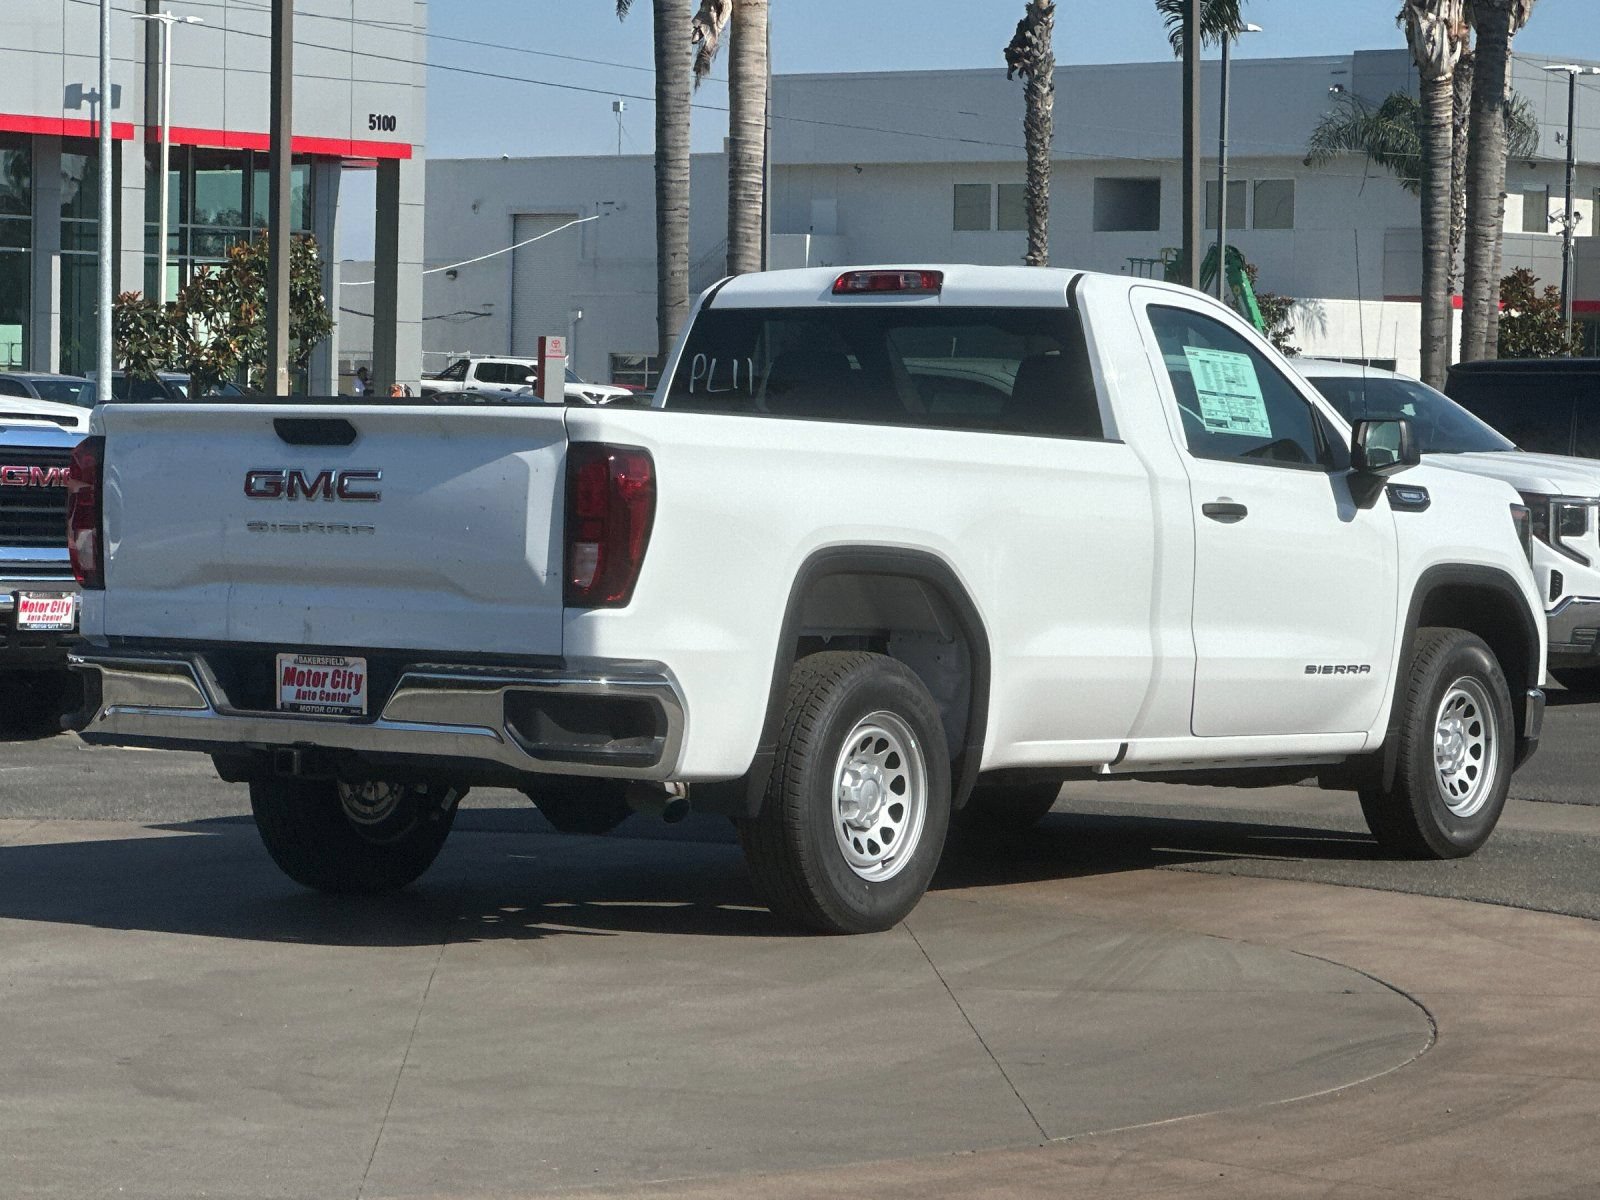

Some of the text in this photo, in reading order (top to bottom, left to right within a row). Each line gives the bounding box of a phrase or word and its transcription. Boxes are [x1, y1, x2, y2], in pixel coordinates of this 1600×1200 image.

[368, 113, 397, 132] 5100
[244, 468, 383, 502] GMC
[20, 600, 72, 616] Motor City
[298, 656, 346, 666] BAKERSFIELD
[1304, 664, 1371, 675] SIERRA
[282, 666, 364, 696] Motor City
[295, 688, 352, 703] Auto Center
[299, 704, 326, 714] MOTOR
[326, 706, 344, 714] CITY
